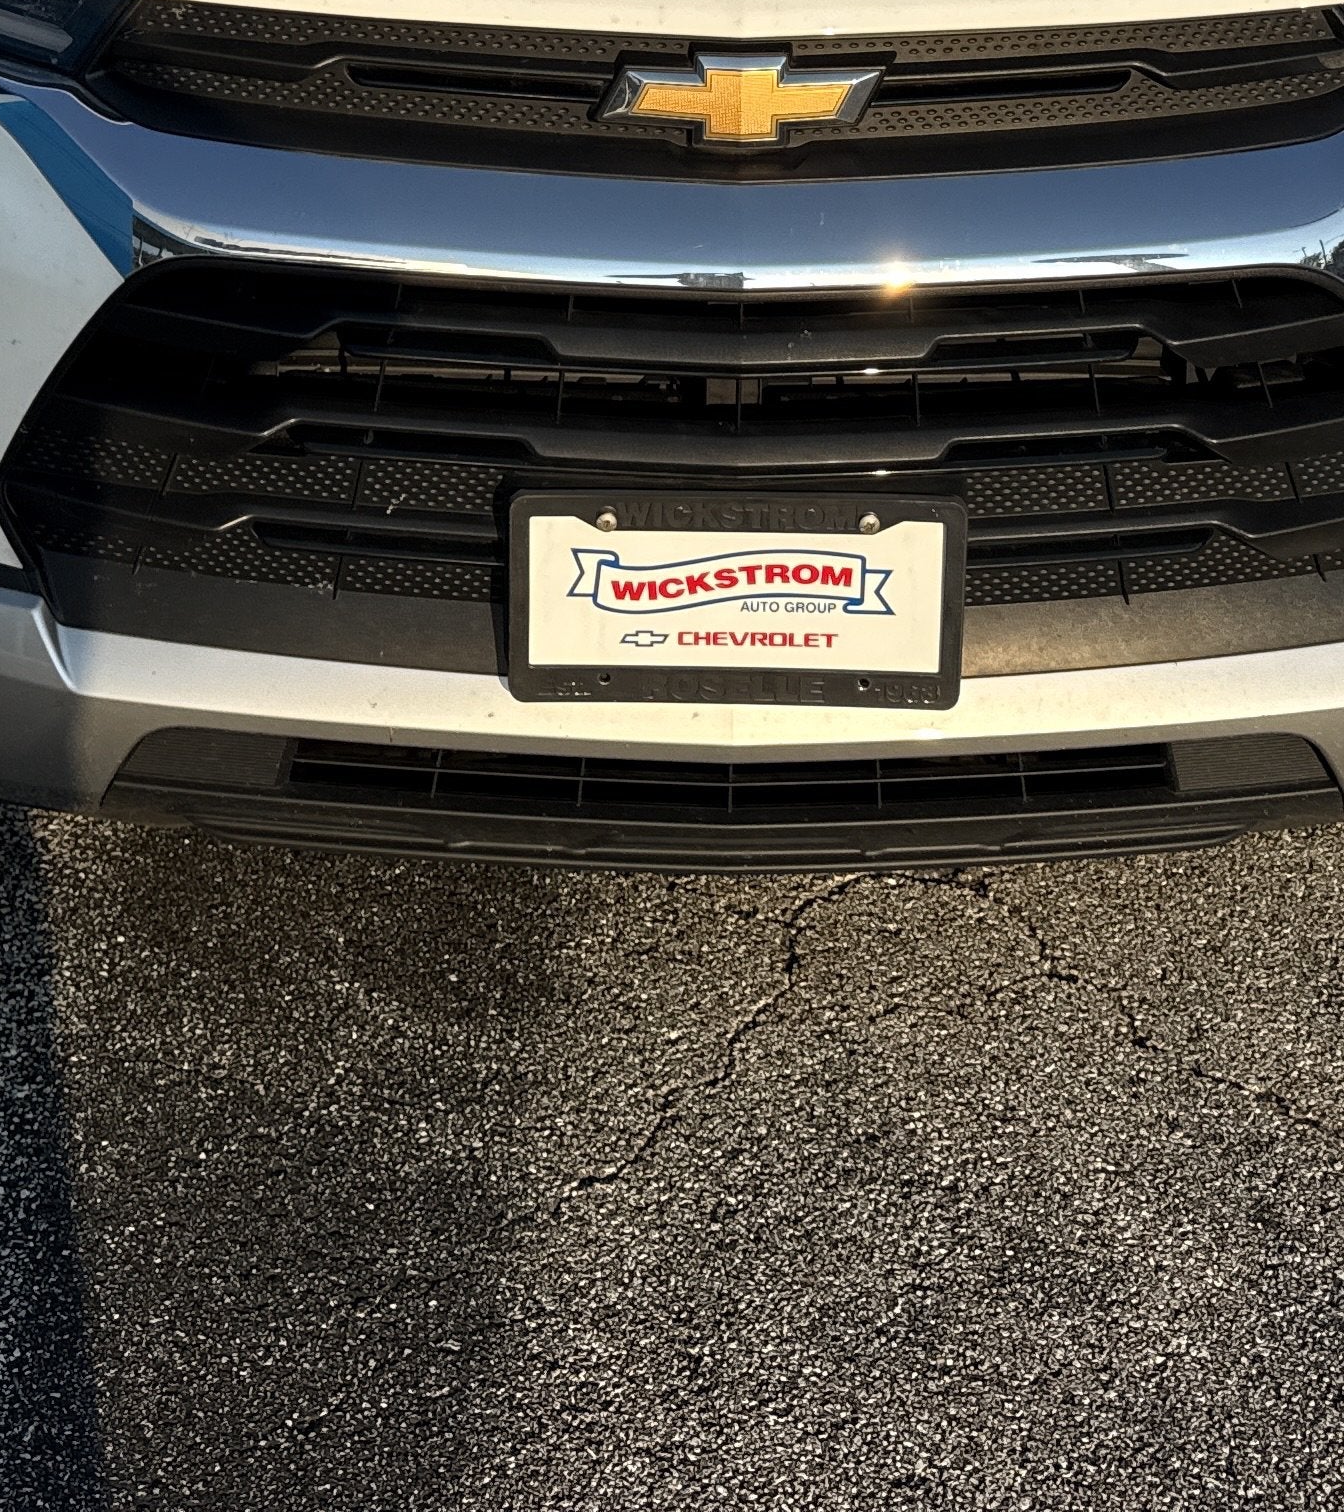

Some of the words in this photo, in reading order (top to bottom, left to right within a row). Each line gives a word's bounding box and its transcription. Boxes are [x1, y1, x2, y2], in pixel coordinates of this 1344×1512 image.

[616, 501, 857, 530] WICKSTROM
[611, 564, 853, 601] WICKSTROM
[740, 601, 780, 613] AUTO
[784, 602, 837, 614] GROUP
[677, 631, 839, 648] CHEVROLET
[642, 672, 825, 703] ROSELLE
